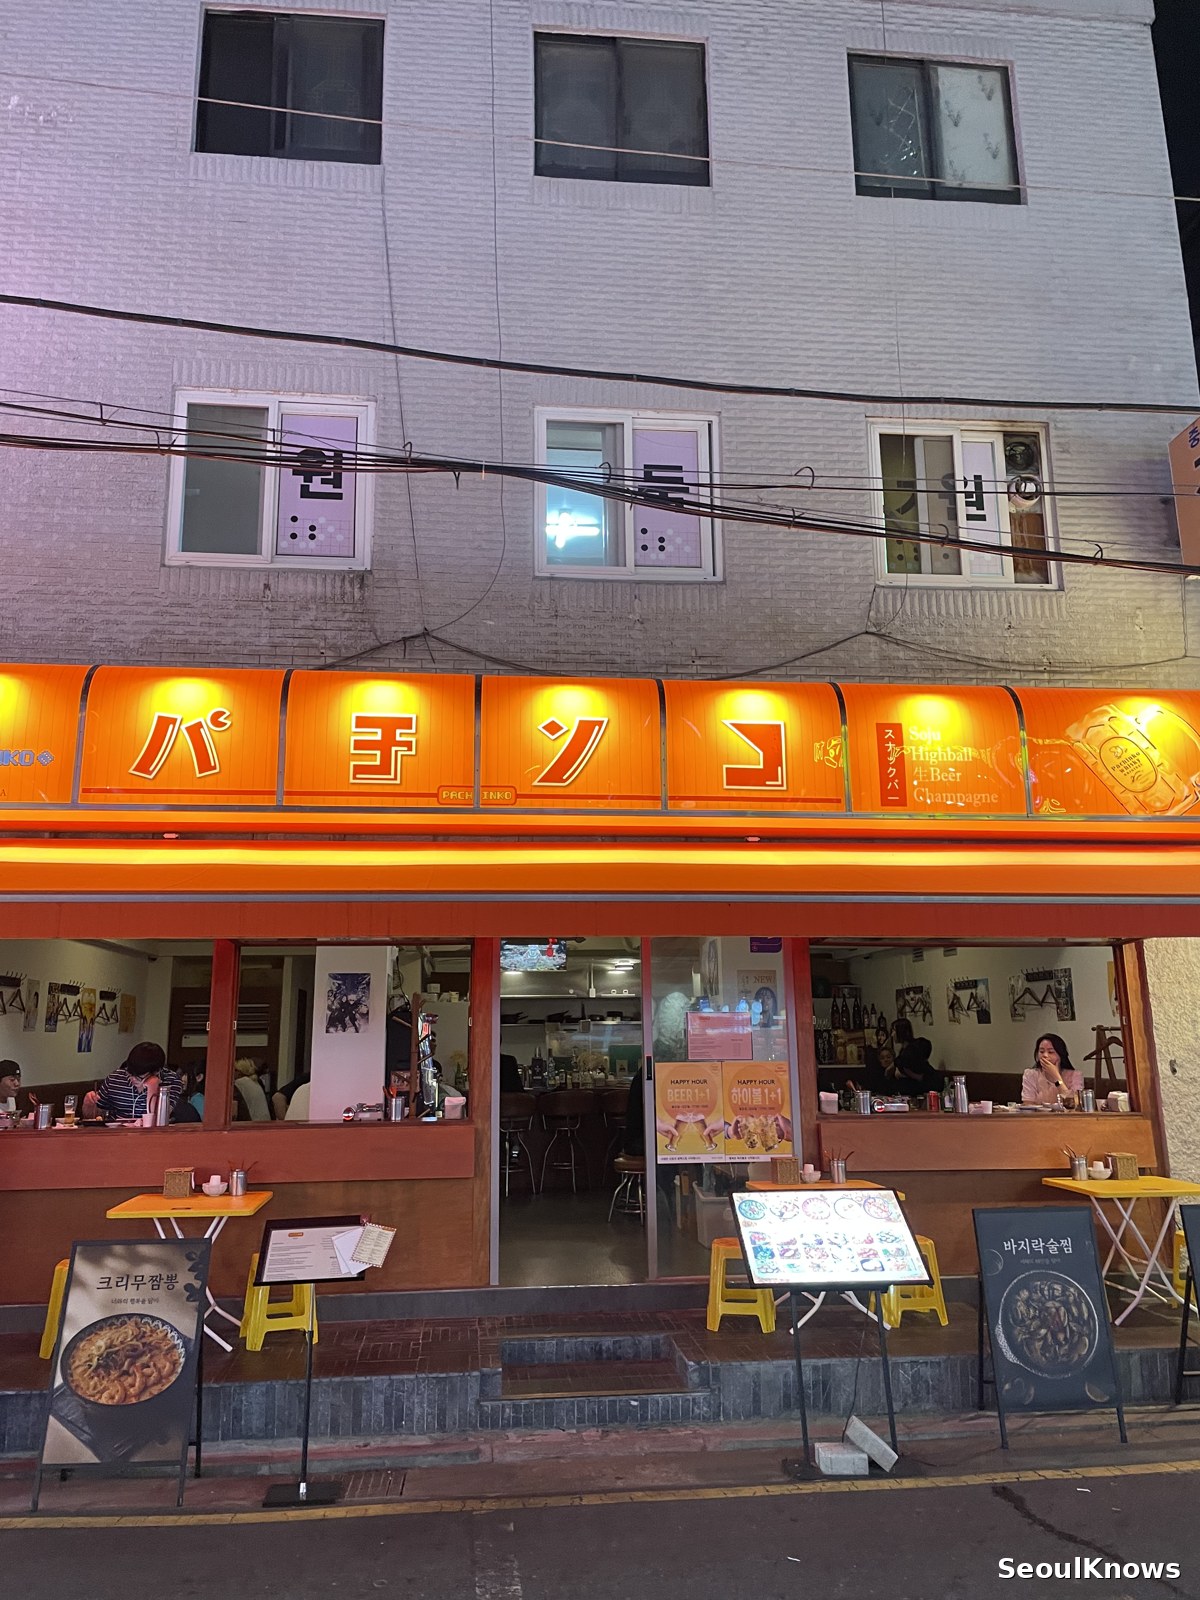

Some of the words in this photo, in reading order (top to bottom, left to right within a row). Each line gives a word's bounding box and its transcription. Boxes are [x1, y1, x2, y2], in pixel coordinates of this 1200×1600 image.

[291, 448, 344, 500] 원
[909, 725, 941, 745] Soju
[128, 707, 788, 791] パチンコ
[911, 746, 973, 766] Highball
[883, 728, 900, 801] スナックバー
[913, 787, 999, 807] Champagne
[667, 1088, 692, 1103] BEER
[694, 1088, 710, 1101] 1+1
[731, 1088, 762, 1105] 하이볼
[764, 1088, 782, 1104] 1+1
[1003, 1236, 1073, 1255] 바지락술찜
[96, 1273, 179, 1291] 크리무짬뽕
